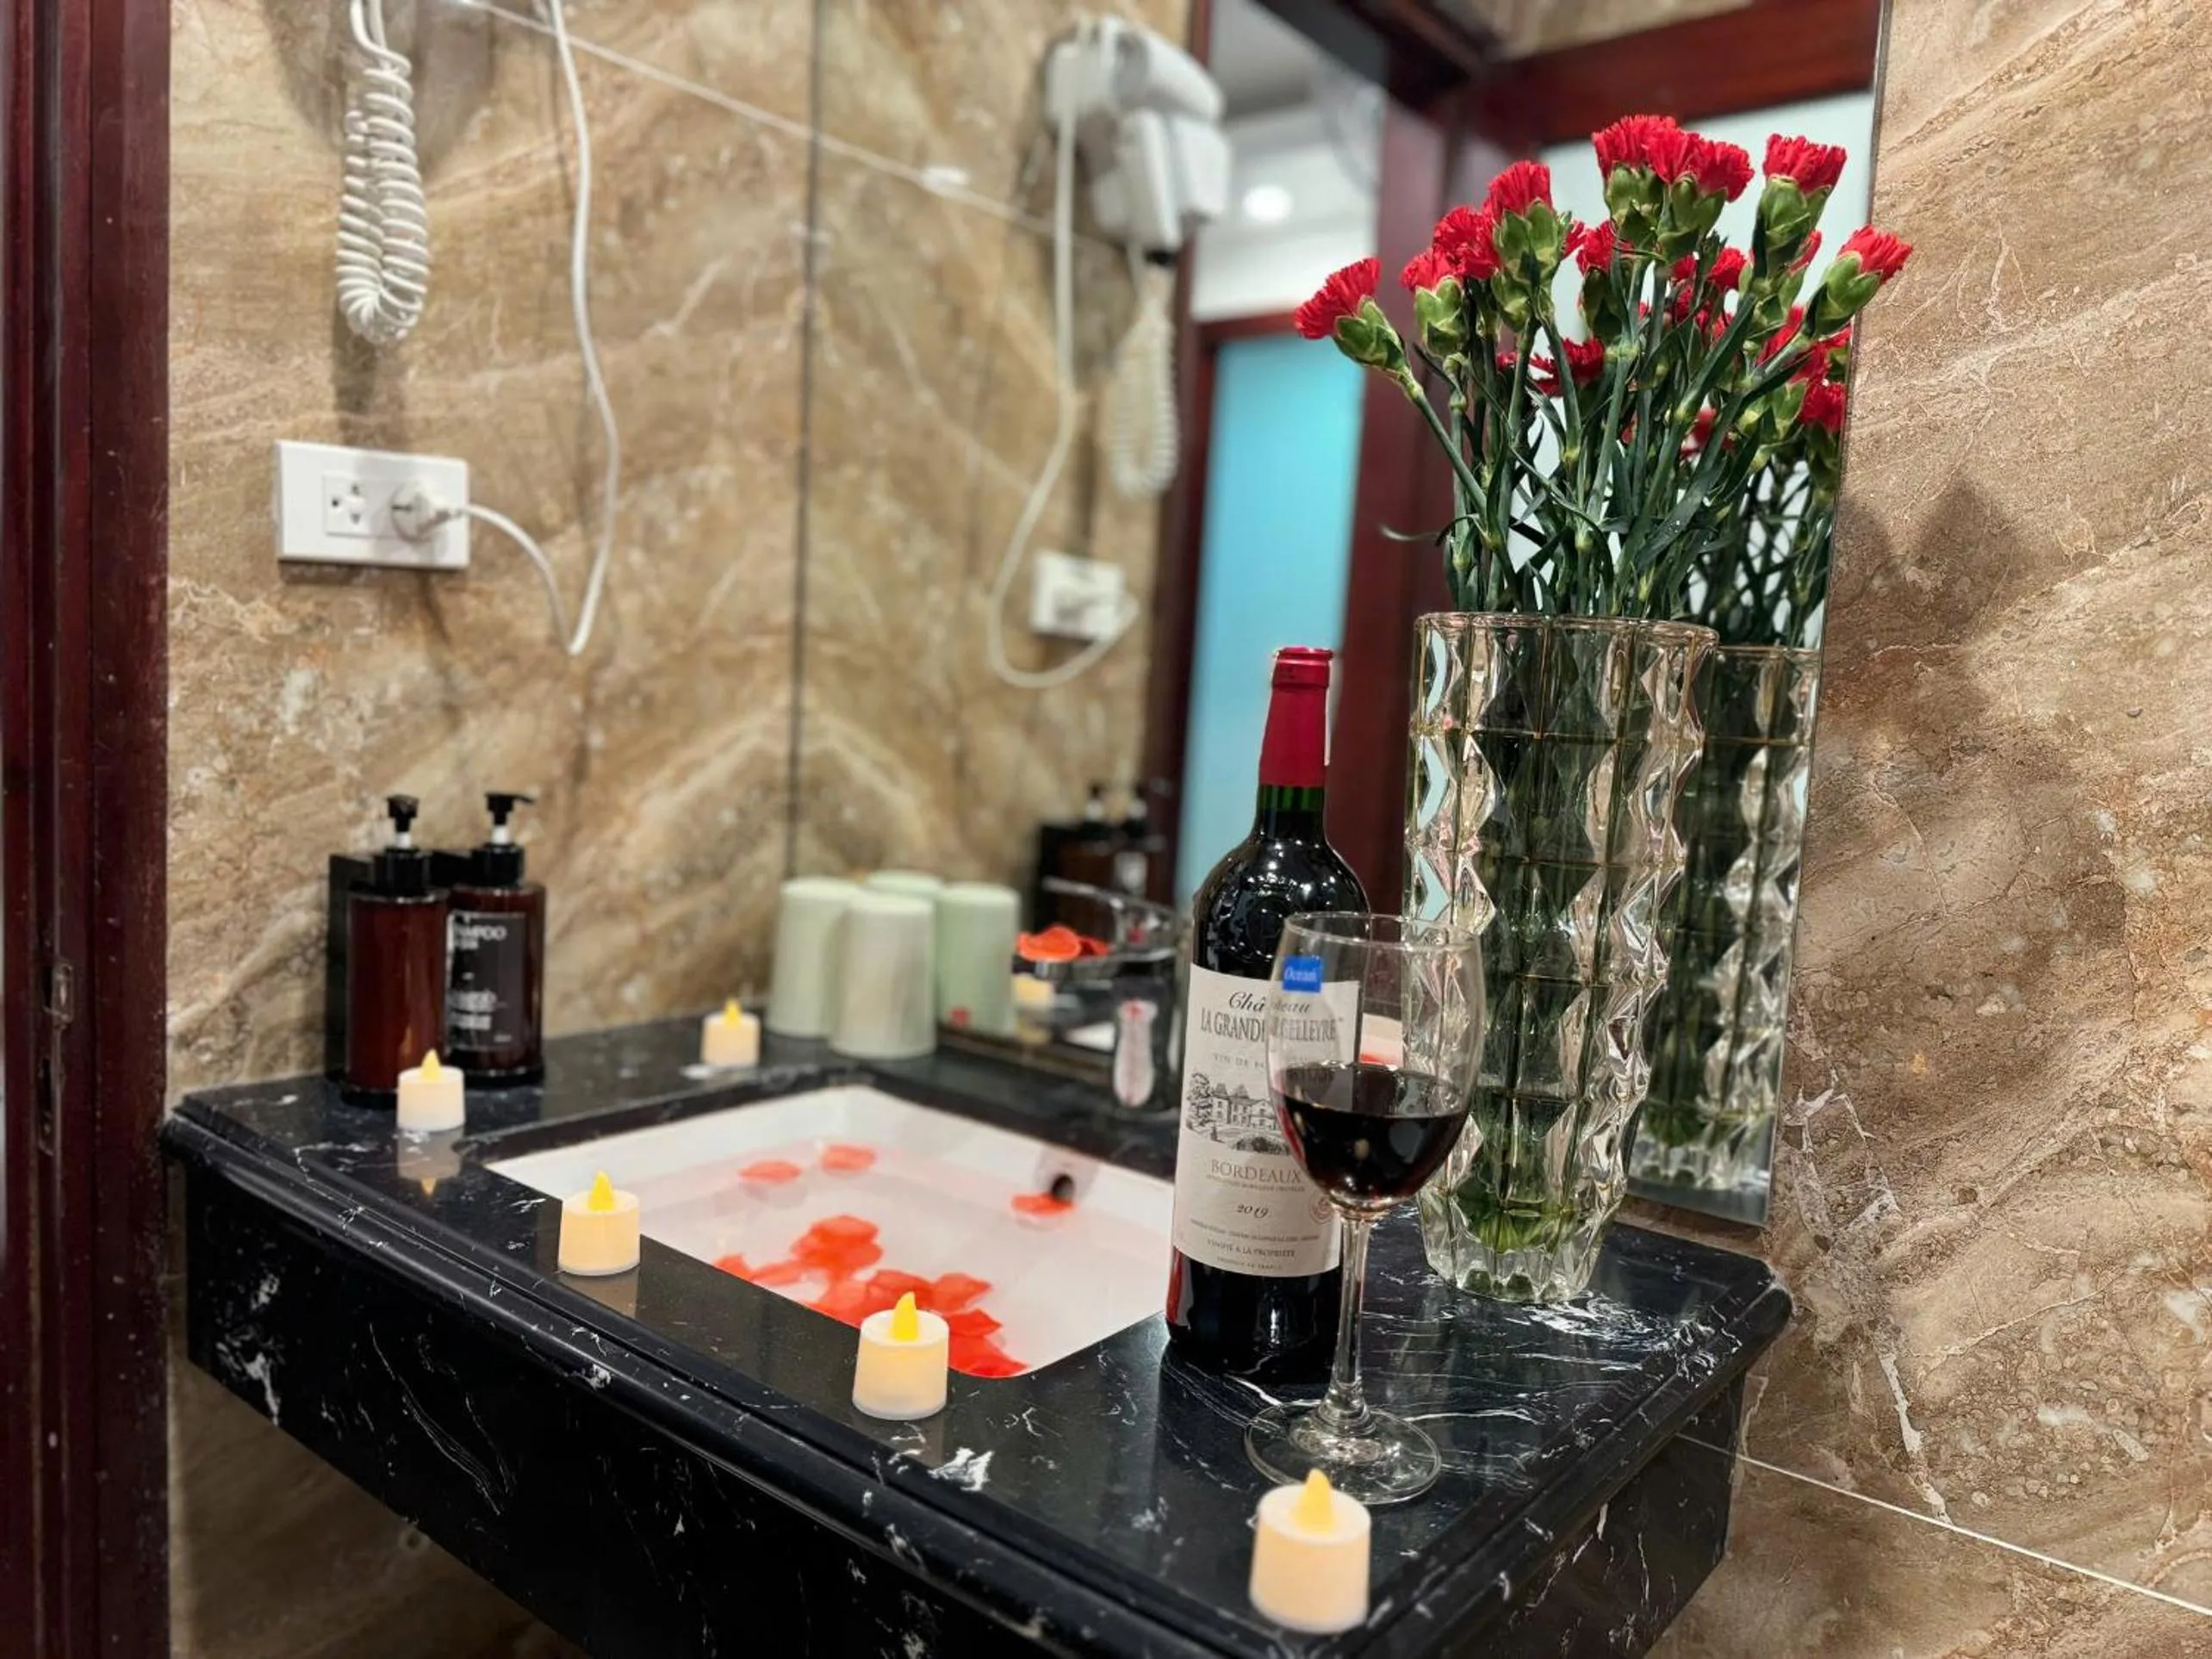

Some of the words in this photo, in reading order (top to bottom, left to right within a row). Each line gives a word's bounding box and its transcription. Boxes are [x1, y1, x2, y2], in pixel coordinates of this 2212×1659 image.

[1201, 1007, 1213, 1034] LA
[1211, 1159, 1301, 1184] BORDEAUX
[1237, 1204, 1270, 1219] 2019
